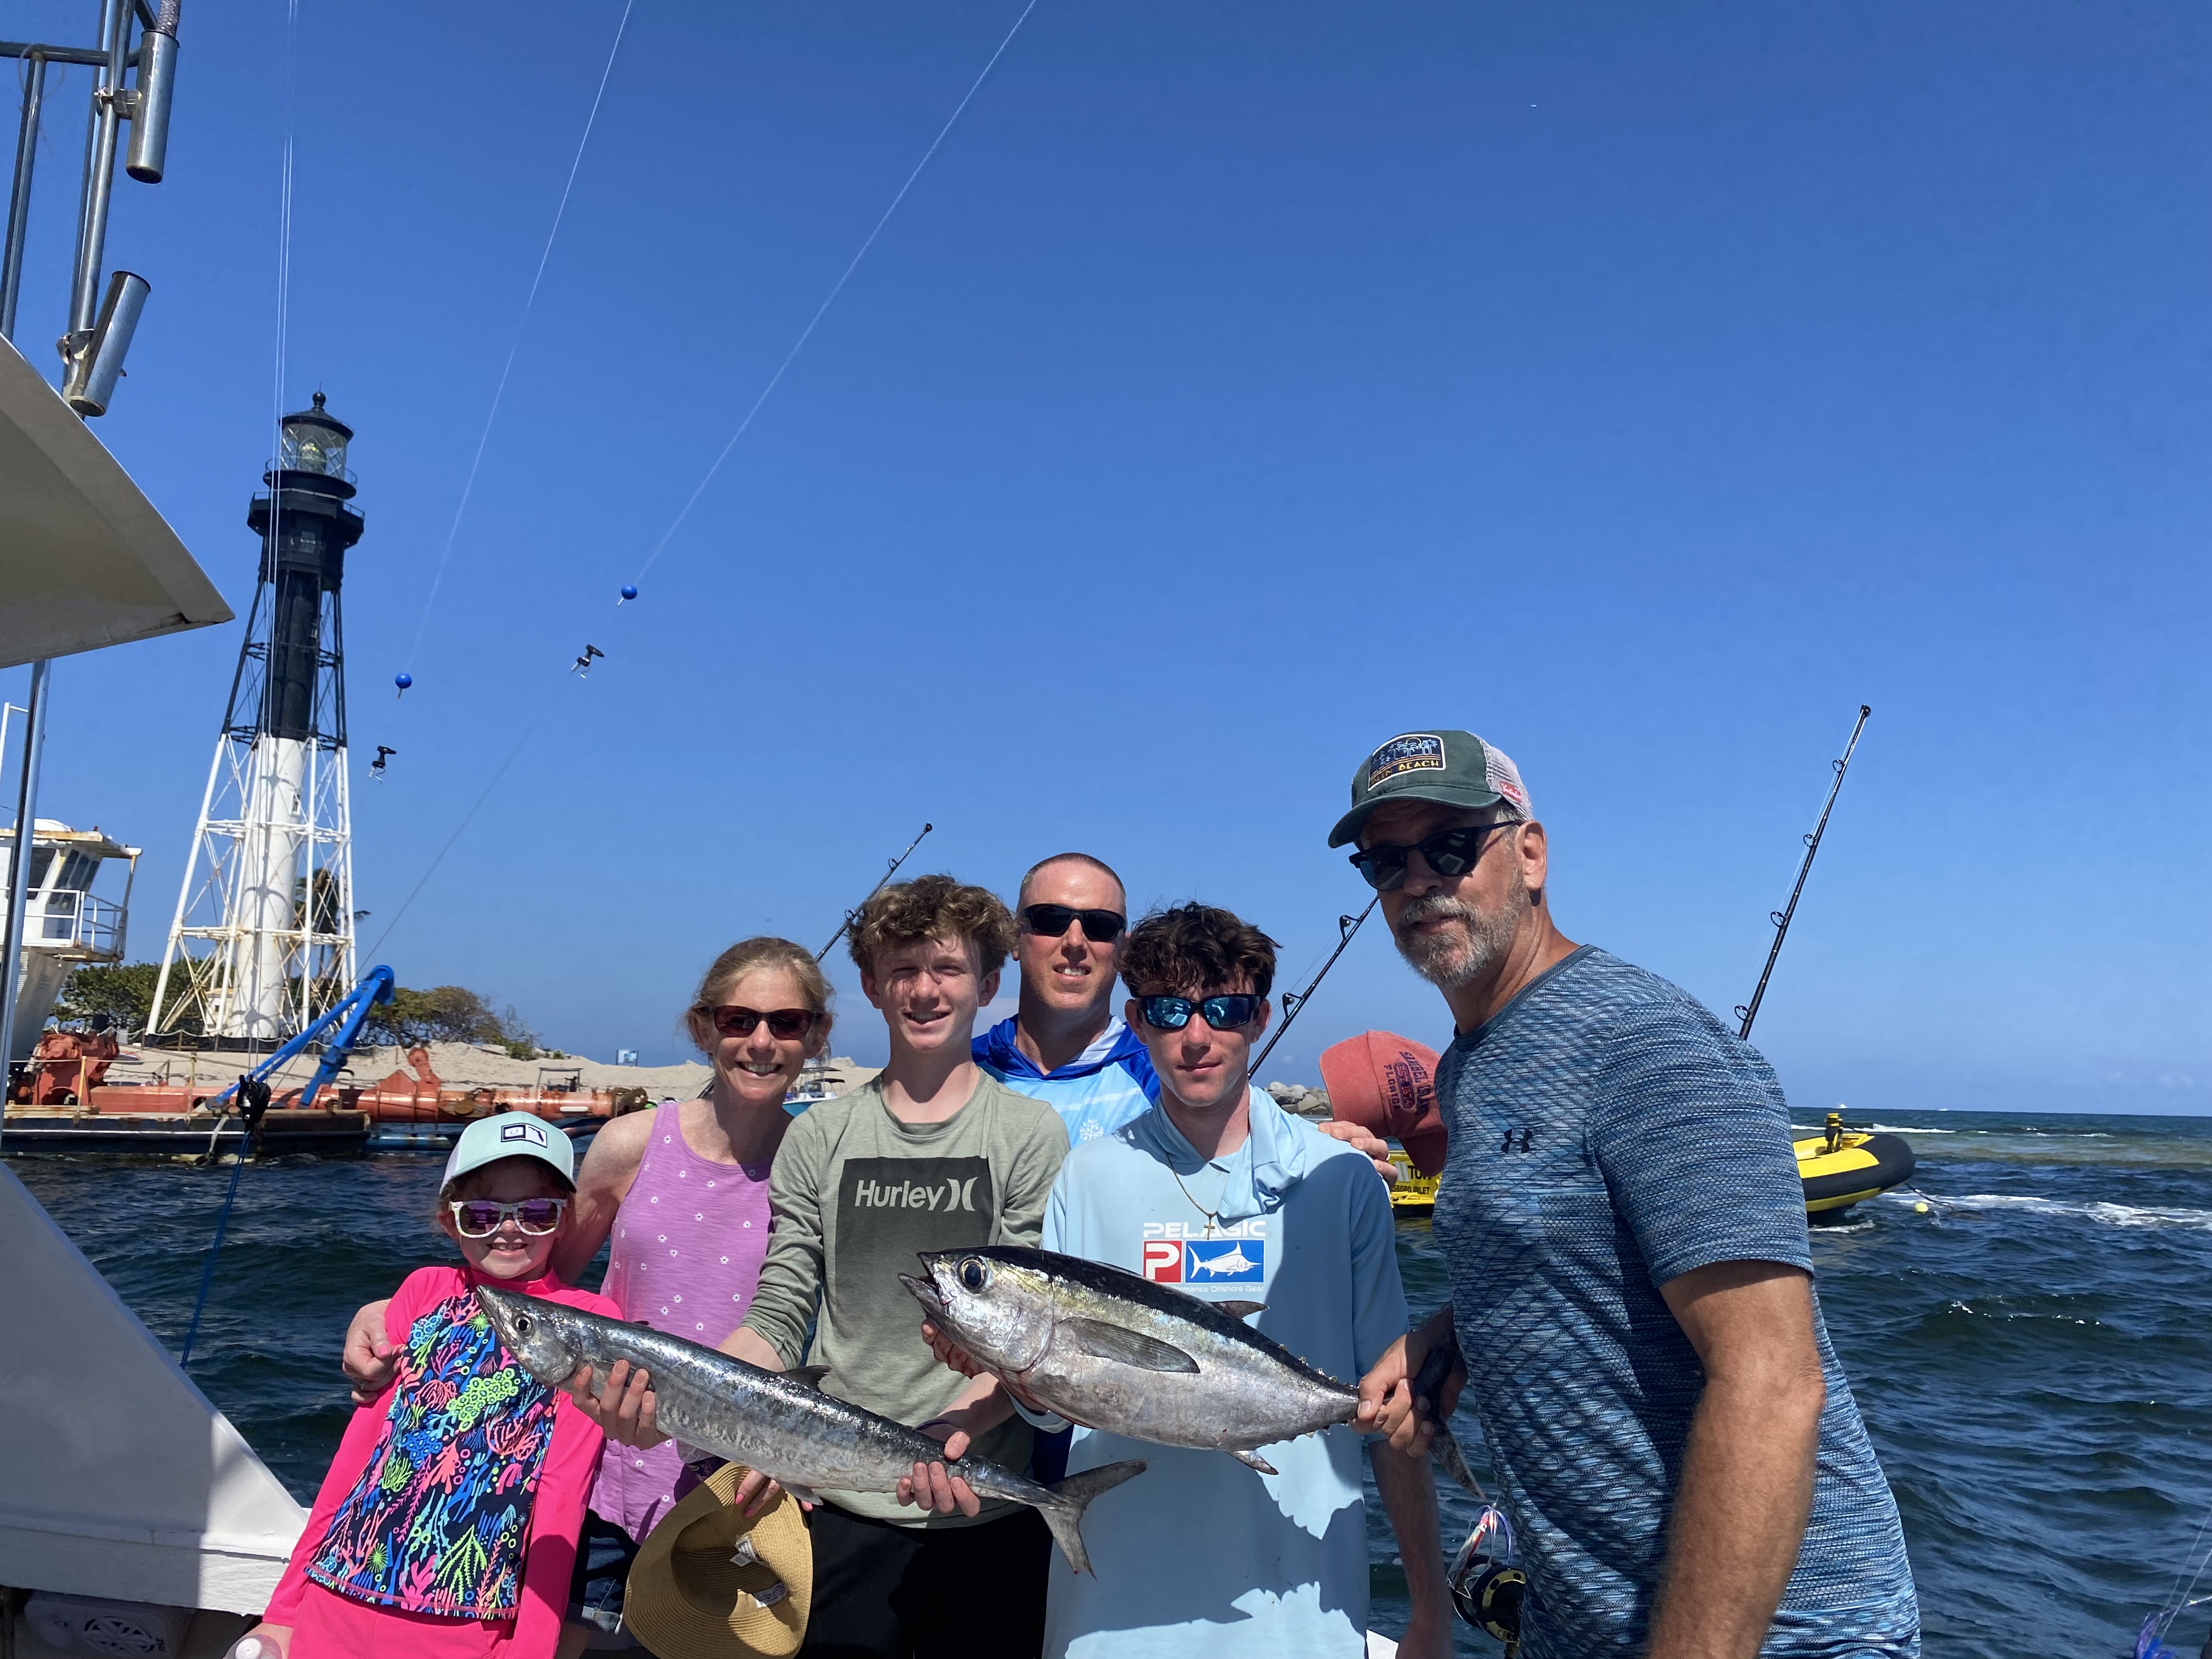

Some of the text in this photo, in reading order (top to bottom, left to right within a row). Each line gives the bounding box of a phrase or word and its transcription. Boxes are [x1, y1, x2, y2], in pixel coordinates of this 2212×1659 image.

[1398, 760, 1439, 771] BEACH
[1384, 1064, 1401, 1111] FLORIDA
[1408, 1165, 1431, 1180] TO
[854, 1180, 946, 1211] Hurley
[1143, 1220, 1266, 1238] PELAGIC
